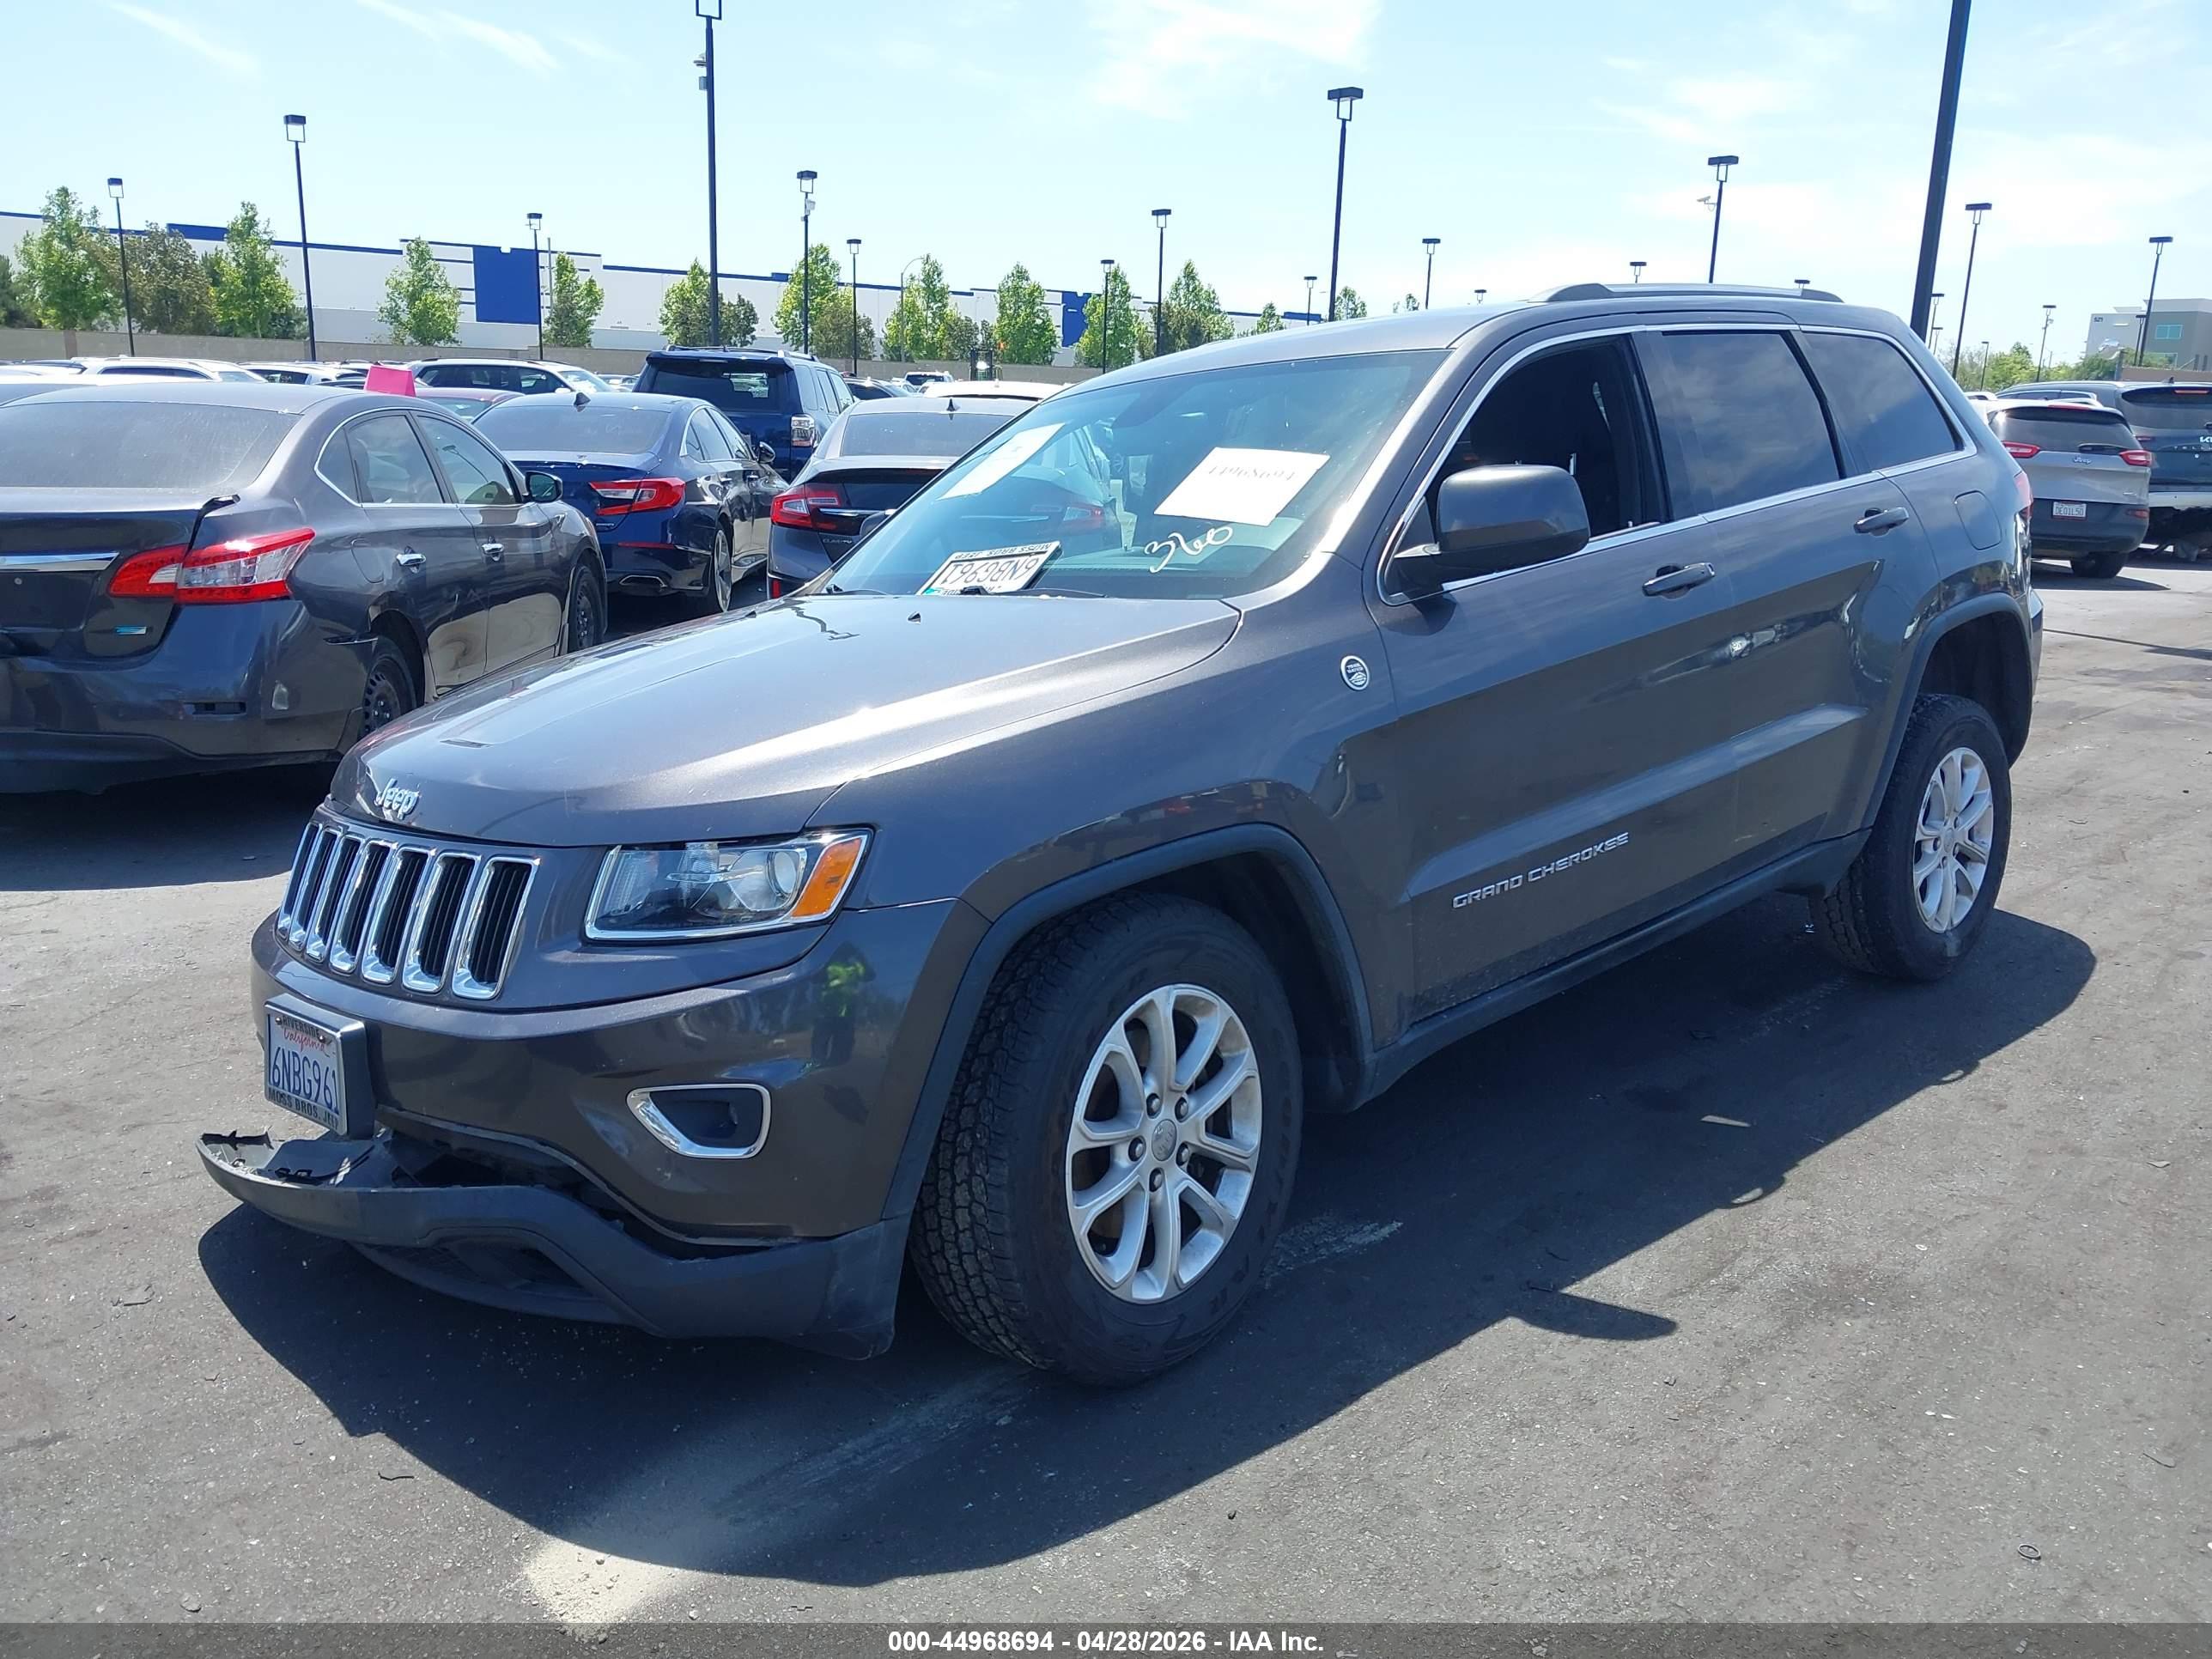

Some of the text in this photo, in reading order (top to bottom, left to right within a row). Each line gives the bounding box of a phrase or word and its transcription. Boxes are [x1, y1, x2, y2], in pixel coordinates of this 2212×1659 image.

[941, 558, 1040, 585] 6NBG961
[1144, 526, 1234, 574] 360
[374, 778, 419, 820] Jeep
[1453, 832, 1630, 909] GRAND CHEROKEE
[283, 1028, 325, 1053] California
[271, 1047, 340, 1115] 6NBG961
[268, 1087, 293, 1109] MOSS
[323, 1110, 339, 1130] JEEP
